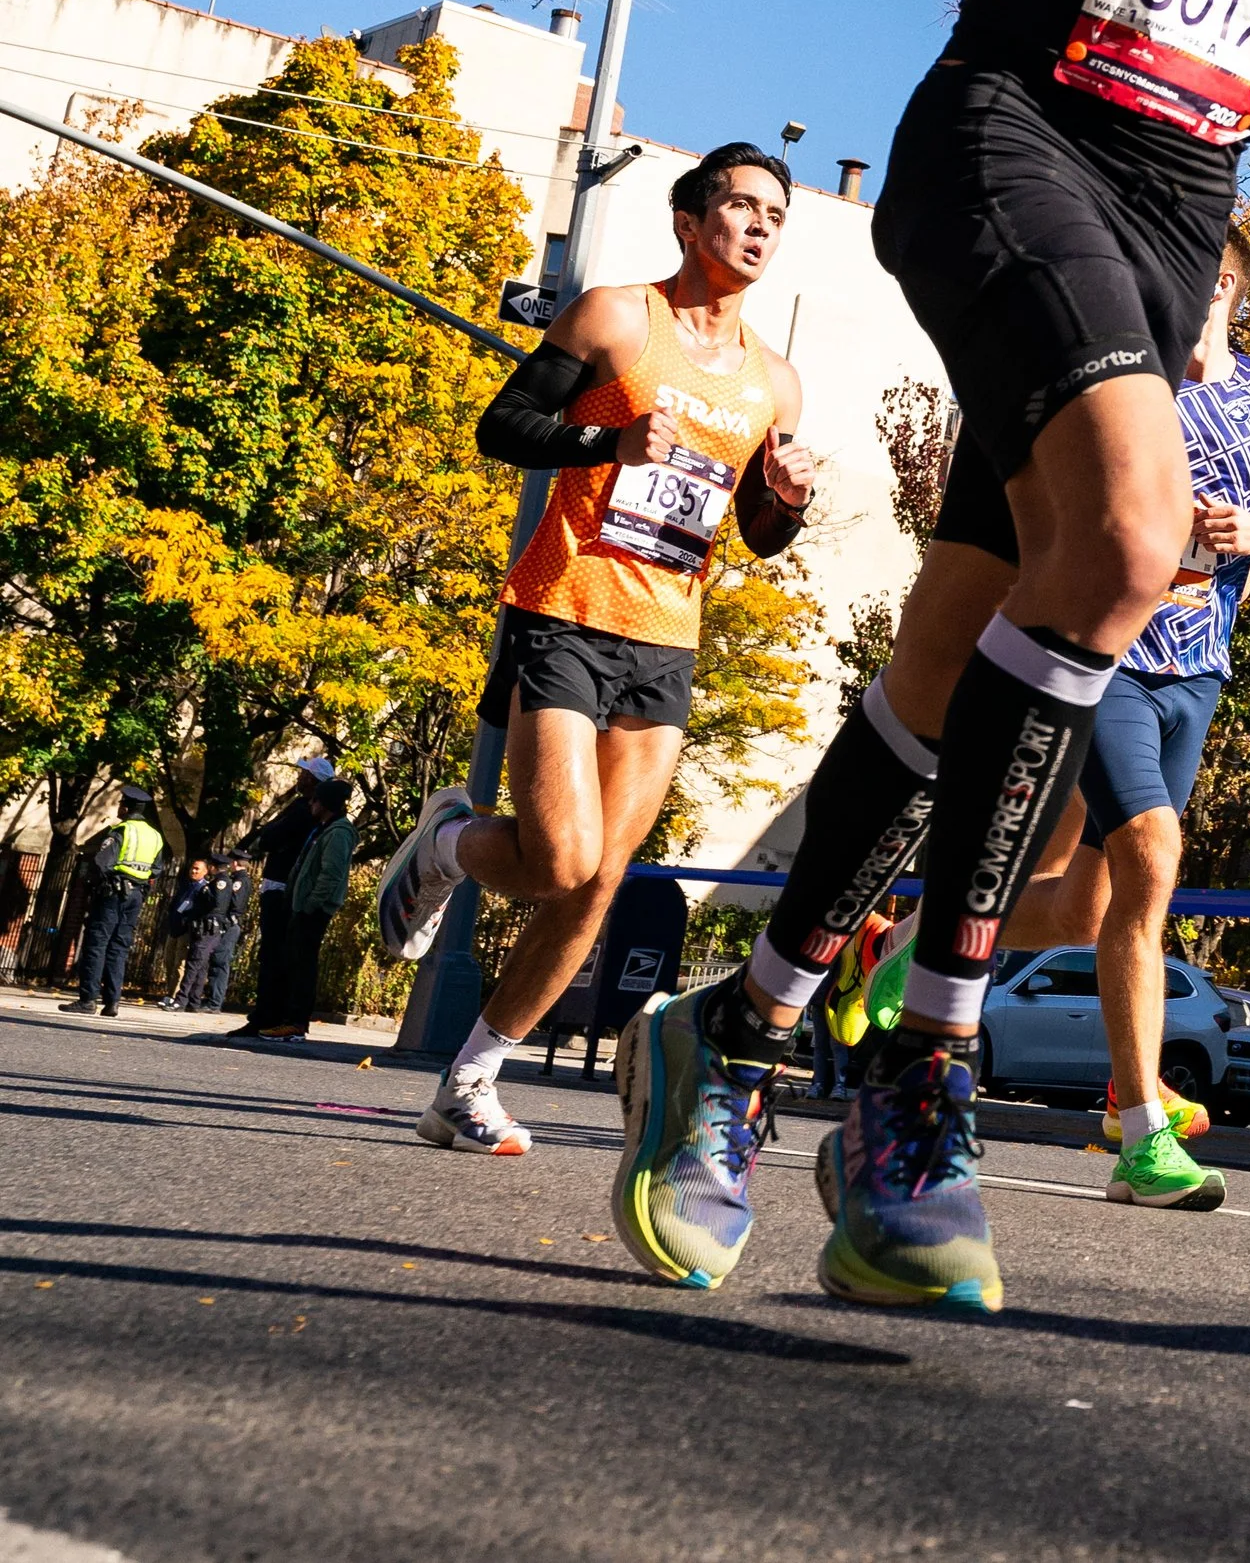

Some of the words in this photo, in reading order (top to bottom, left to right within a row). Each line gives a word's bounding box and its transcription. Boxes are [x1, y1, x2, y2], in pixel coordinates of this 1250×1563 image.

[1129, 9, 1138, 24] 1
[1206, 43, 1217, 56] A
[521, 297, 552, 318] ONE
[655, 384, 750, 439] STRAVA
[646, 469, 711, 522] 1851
[679, 518, 686, 527] A
[678, 550, 697, 564] 2024
[1173, 583, 1198, 597] 2024
